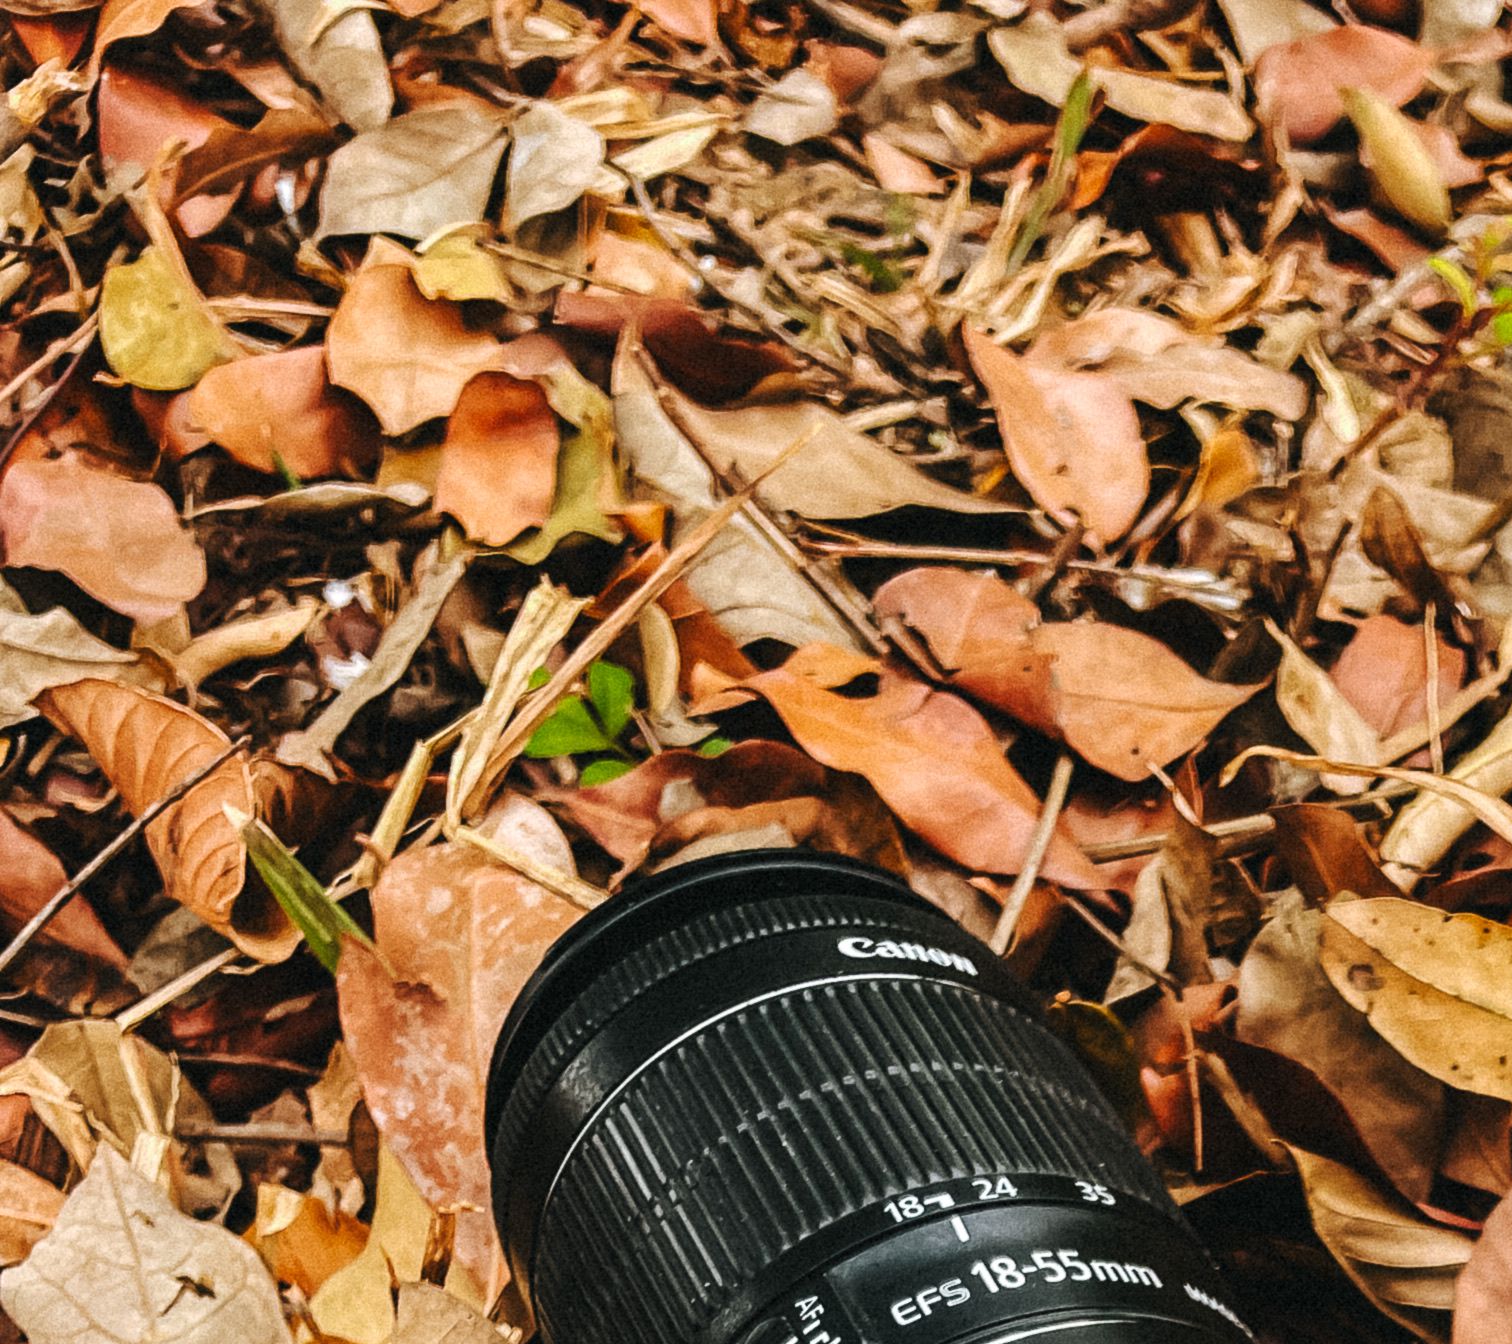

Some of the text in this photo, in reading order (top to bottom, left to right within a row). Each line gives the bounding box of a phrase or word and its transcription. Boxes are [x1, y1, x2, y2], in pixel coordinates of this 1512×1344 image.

[838, 936, 979, 976] Canon
[884, 1176, 1117, 1223] 18 24 35
[970, 1248, 1163, 1294] 18-55mm
[794, 1295, 825, 1321] AF
